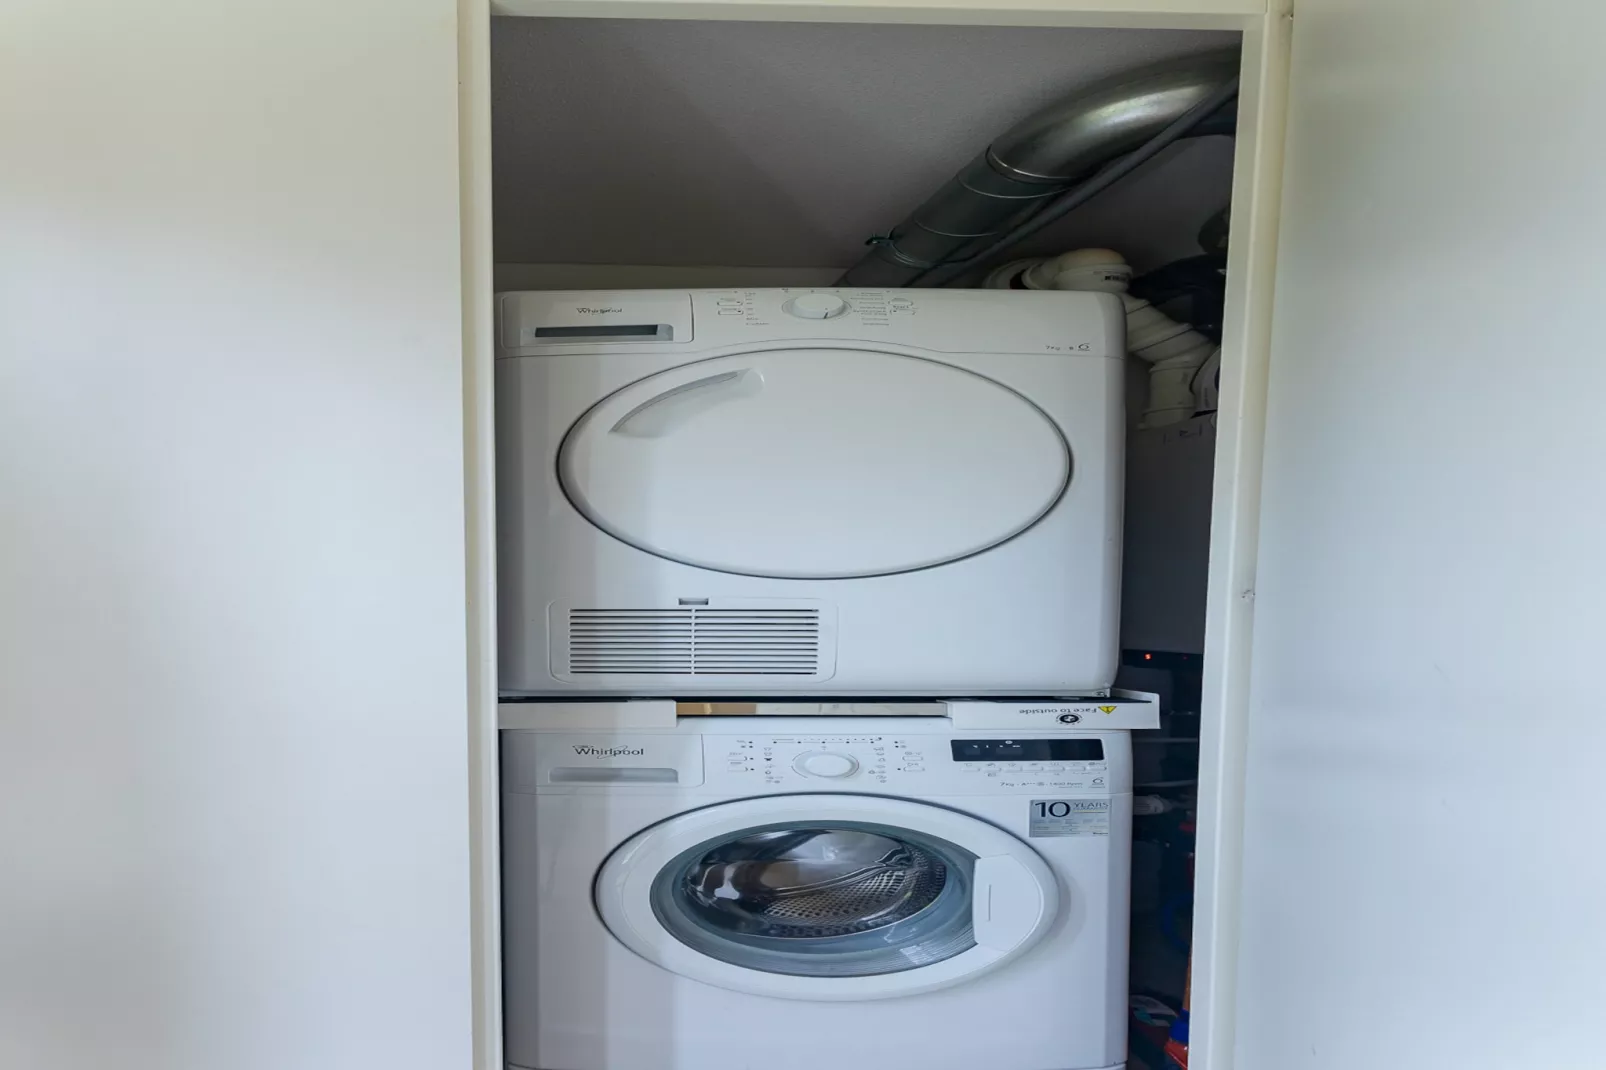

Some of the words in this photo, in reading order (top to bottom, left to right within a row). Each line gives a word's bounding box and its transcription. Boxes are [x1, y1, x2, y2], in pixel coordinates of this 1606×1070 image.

[1019, 707, 1058, 715] outside
[573, 746, 644, 758] Whirlpool
[1034, 801, 1071, 818] 10
